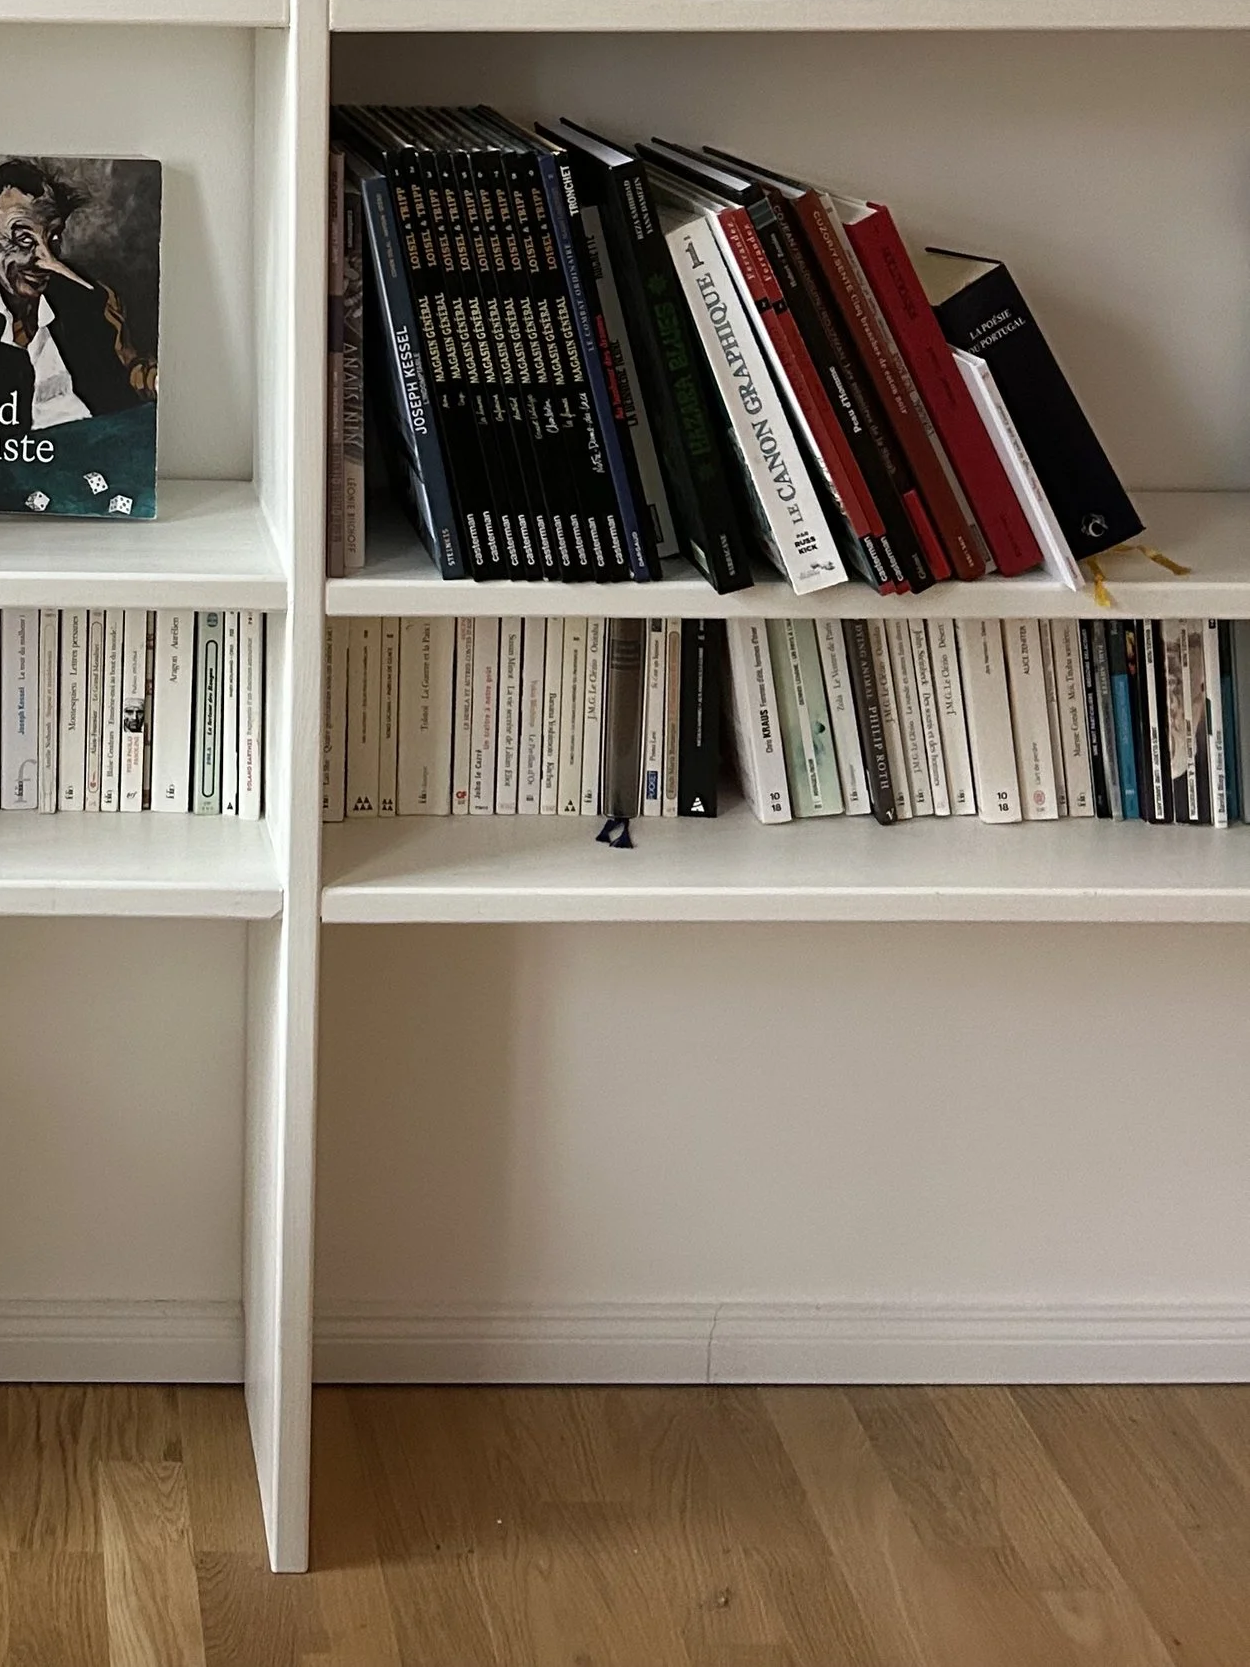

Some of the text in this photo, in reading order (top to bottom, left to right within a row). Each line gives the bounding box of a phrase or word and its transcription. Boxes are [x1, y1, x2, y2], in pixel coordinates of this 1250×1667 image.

[395, 185, 411, 220] TRIPP
[559, 164, 578, 216] TRONCHET
[404, 231, 421, 269] LOISEL
[554, 295, 584, 383] MAGASIN GÉNÉRAL
[395, 324, 427, 436] JOSEPH KESSEL
[694, 270, 804, 525] LE CANON GRAPHIQUE
[826, 364, 862, 433] Peau d'Homme
[464, 512, 484, 565] casterman
[793, 535, 816, 548] RUSS
[797, 544, 818, 555] KICK
[861, 534, 888, 583] casterman
[68, 615, 81, 730] Montesquieu Lettres persanes
[759, 709, 771, 738] KRAUS
